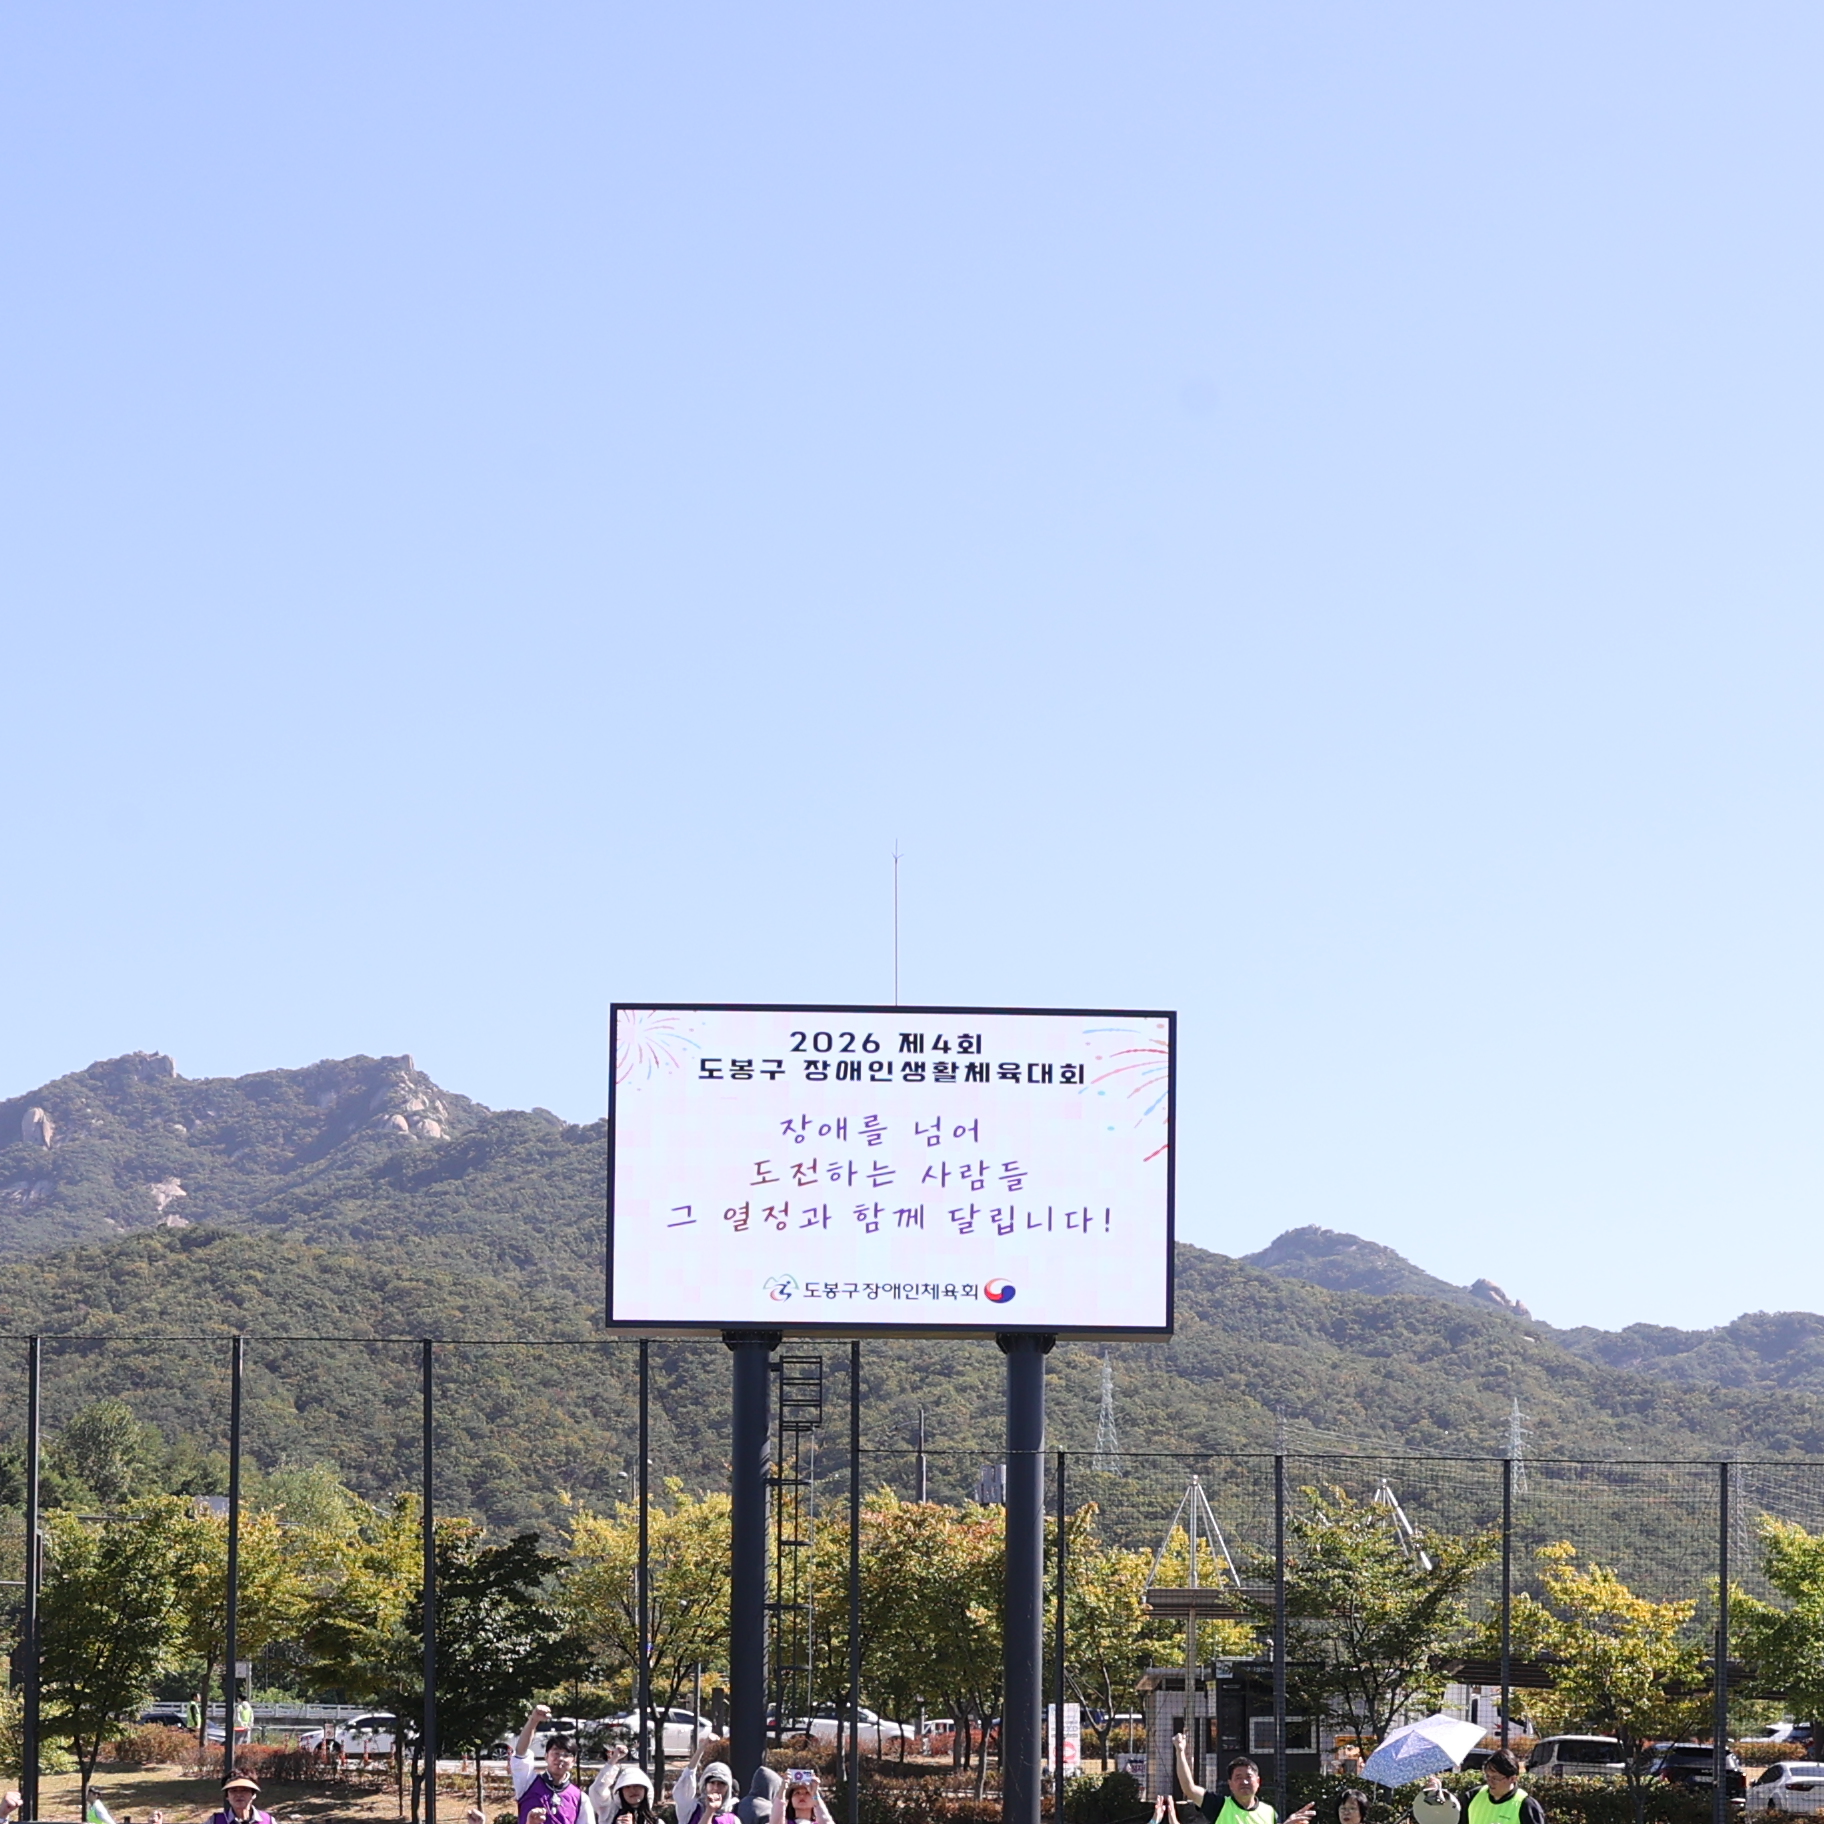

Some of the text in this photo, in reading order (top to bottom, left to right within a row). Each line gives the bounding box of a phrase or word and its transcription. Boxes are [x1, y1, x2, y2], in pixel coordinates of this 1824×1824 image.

[790, 1030, 983, 1055] 2026 제4회
[699, 1057, 1086, 1085] 도봉구 장애인생활체육대회
[779, 1113, 980, 1147] 장애를 넘어
[749, 1157, 1029, 1191] 도전하는 사람들
[667, 1201, 1112, 1236] 그 열정과 함께 달립니다!
[803, 1280, 979, 1302] 도봉구장애인체육회
